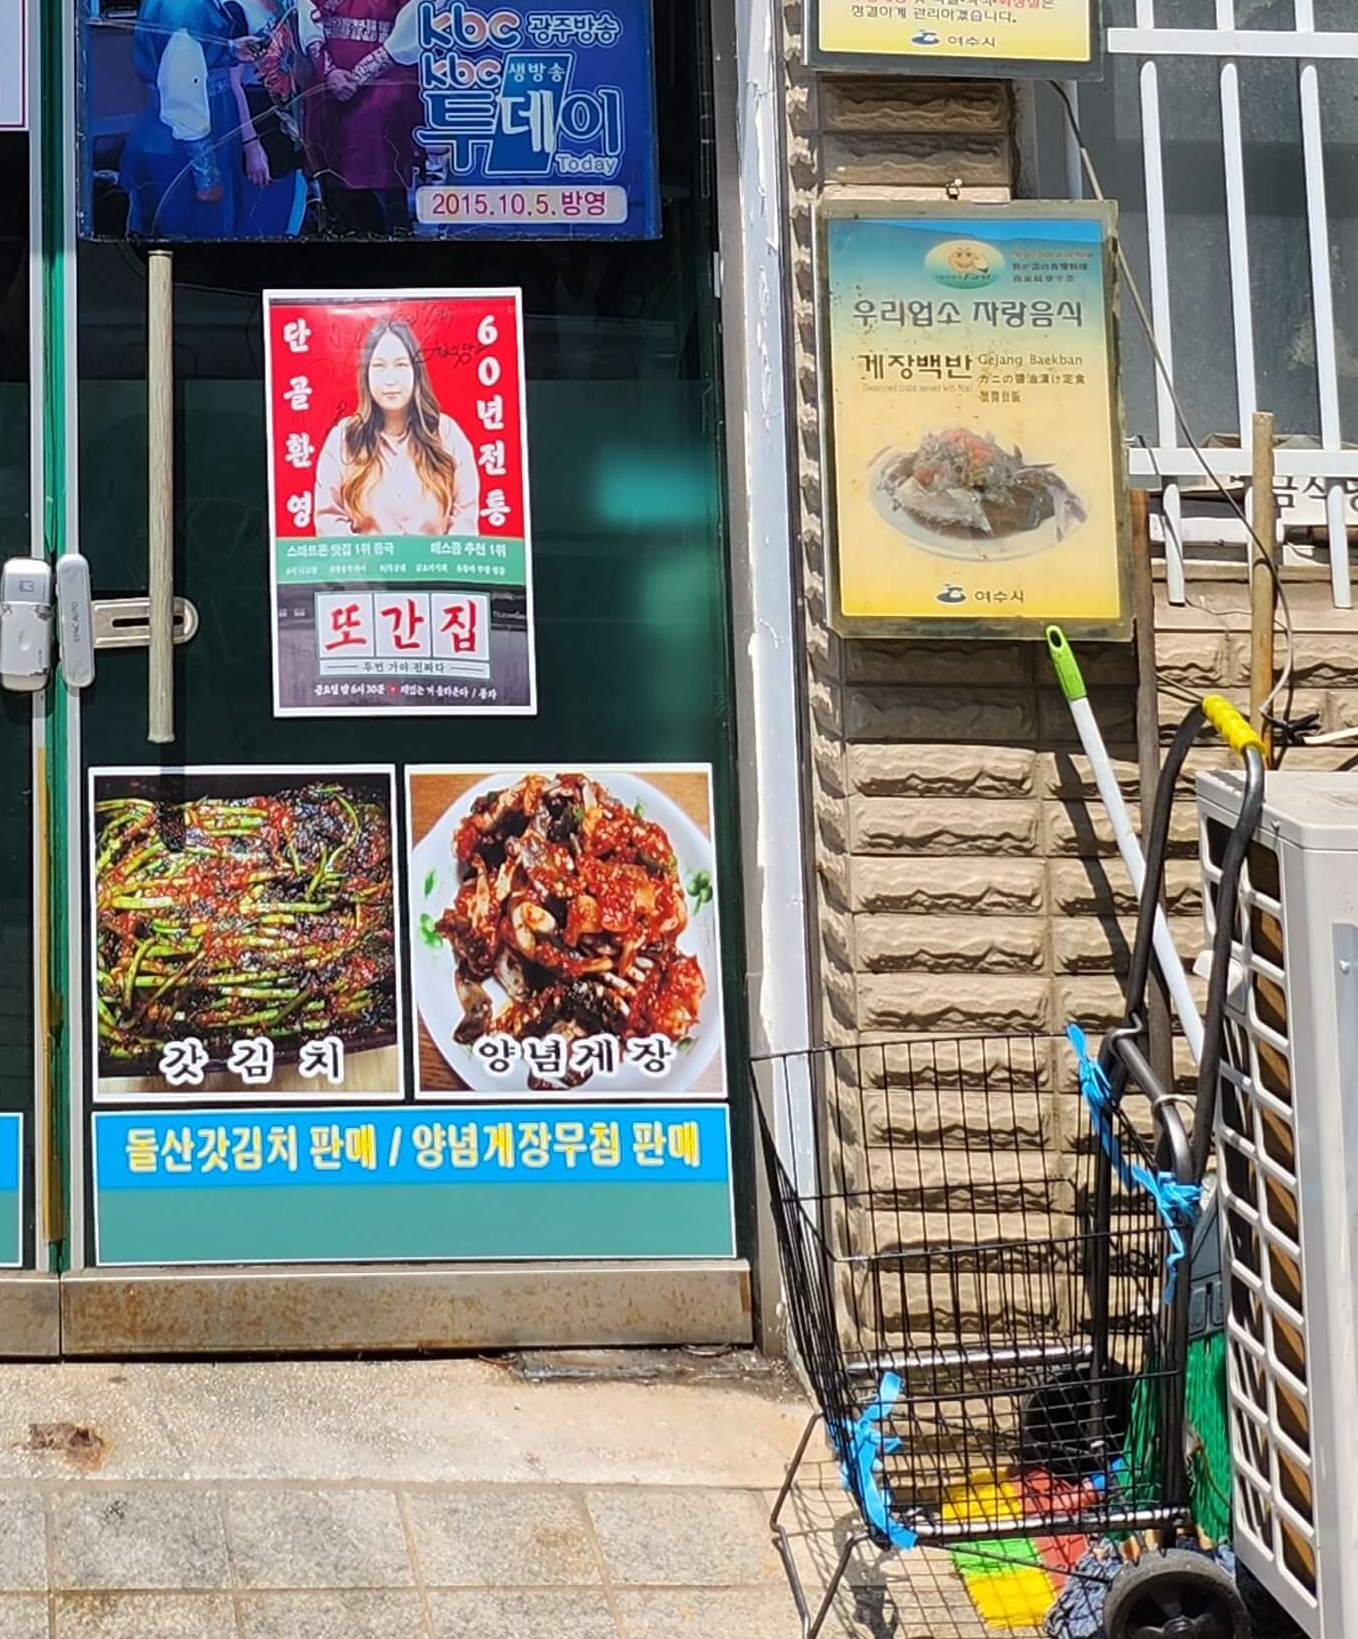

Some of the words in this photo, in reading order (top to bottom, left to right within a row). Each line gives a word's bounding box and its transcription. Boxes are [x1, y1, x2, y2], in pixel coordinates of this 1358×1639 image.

[418, 2, 520, 49] kbc
[528, 14, 620, 44] 광주방송
[947, 36, 996, 48] 여수시
[420, 52, 502, 89] kbc
[508, 63, 566, 83] 생방송
[416, 88, 622, 174] 투데이
[556, 154, 617, 175] Today
[853, 299, 962, 327] 우리업소
[973, 300, 1083, 328] 자랑음식
[858, 354, 973, 380] 게장백반
[977, 353, 1023, 367] Gejang
[1029, 353, 1083, 366] Baekban
[974, 590, 1025, 603] 여수시
[325, 598, 477, 653] 또간집
[161, 1039, 344, 1083] 갓김치
[478, 1036, 673, 1079] 양념게장
[125, 1126, 298, 1173] 돌산갓김치
[309, 1124, 377, 1170] 판매
[411, 1122, 621, 1168] 양념게장무침
[632, 1120, 700, 1167] 판매
